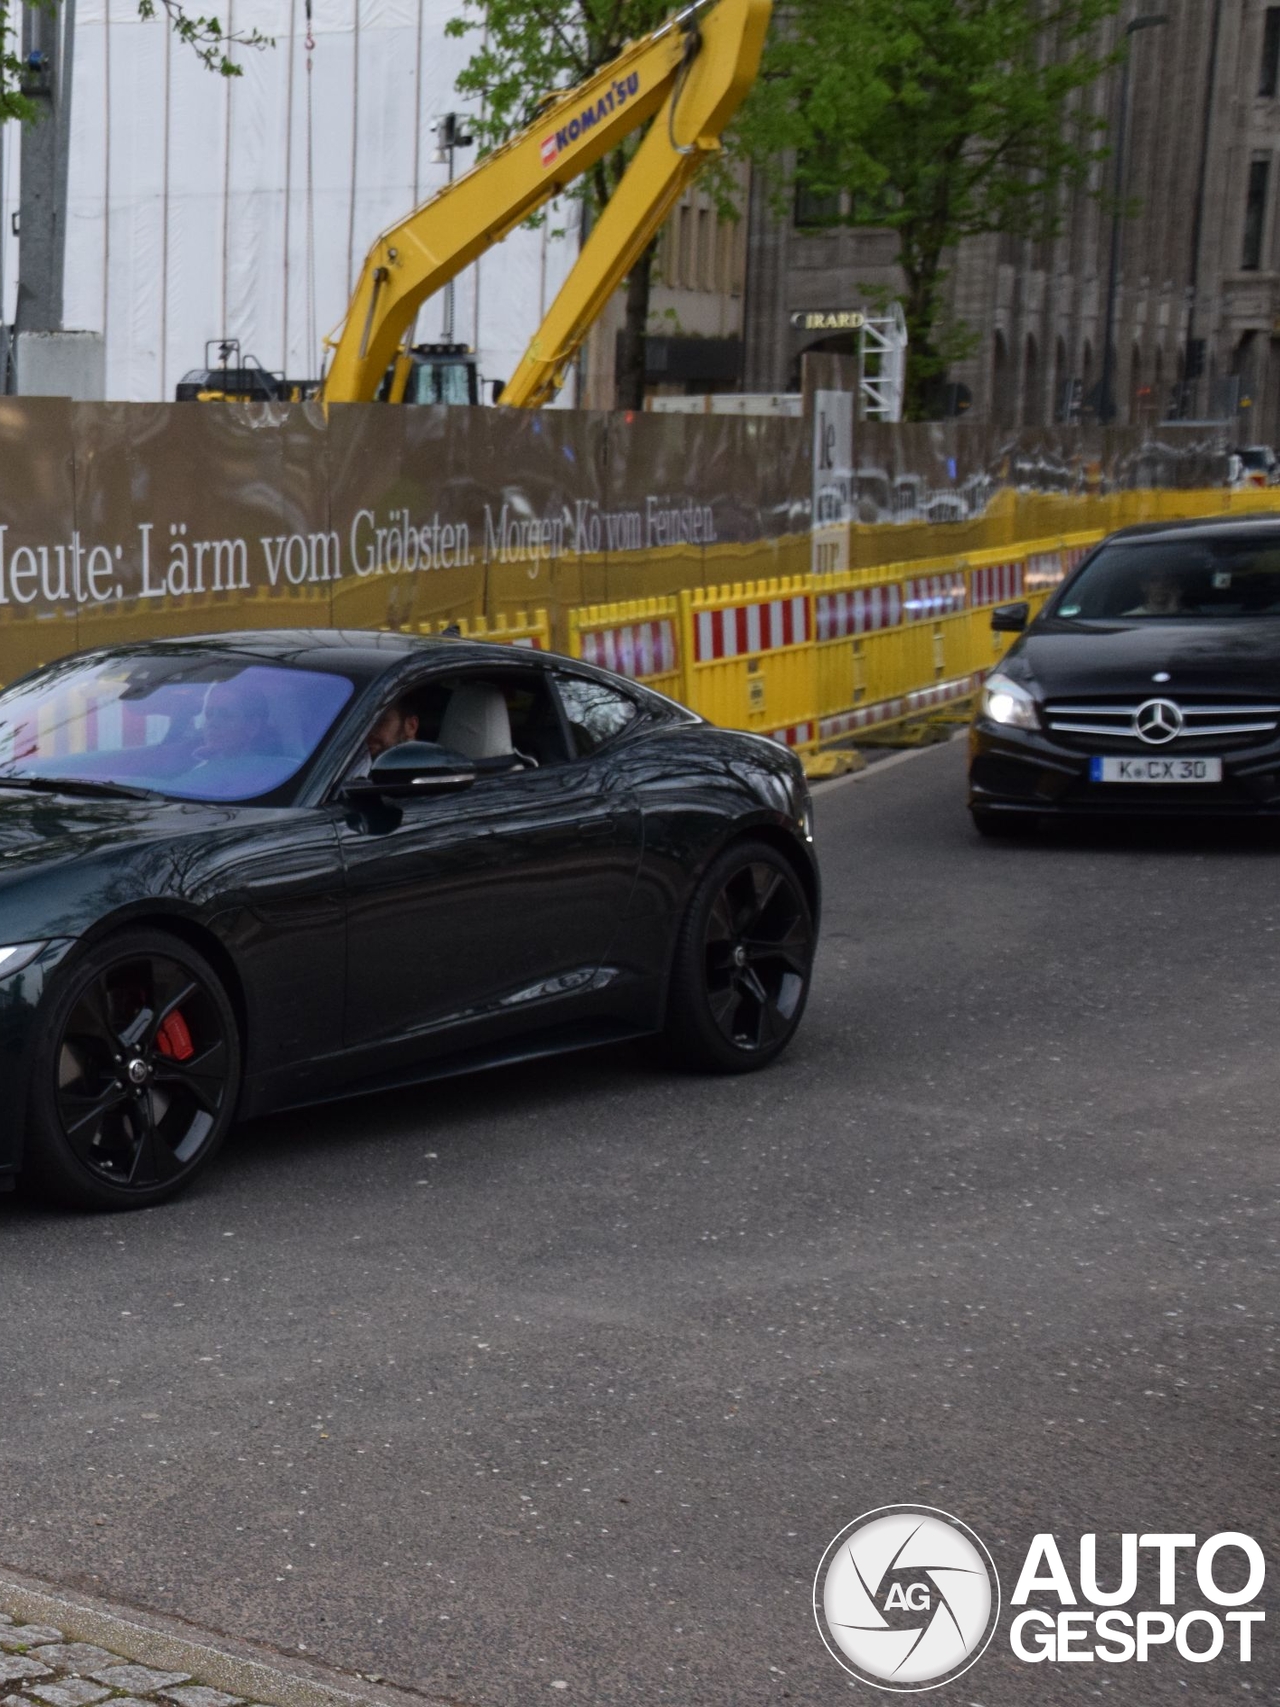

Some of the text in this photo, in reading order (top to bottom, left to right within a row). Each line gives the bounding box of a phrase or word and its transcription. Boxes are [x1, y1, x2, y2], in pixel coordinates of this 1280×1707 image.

[554, 71, 639, 153] KOMATSU
[138, 522, 250, 598] Lärm
[260, 530, 342, 586] vom
[350, 508, 475, 578] Gröbsten.
[603, 511, 642, 552] vom
[1120, 761, 1132, 778] K
[1148, 761, 1174, 779] CX
